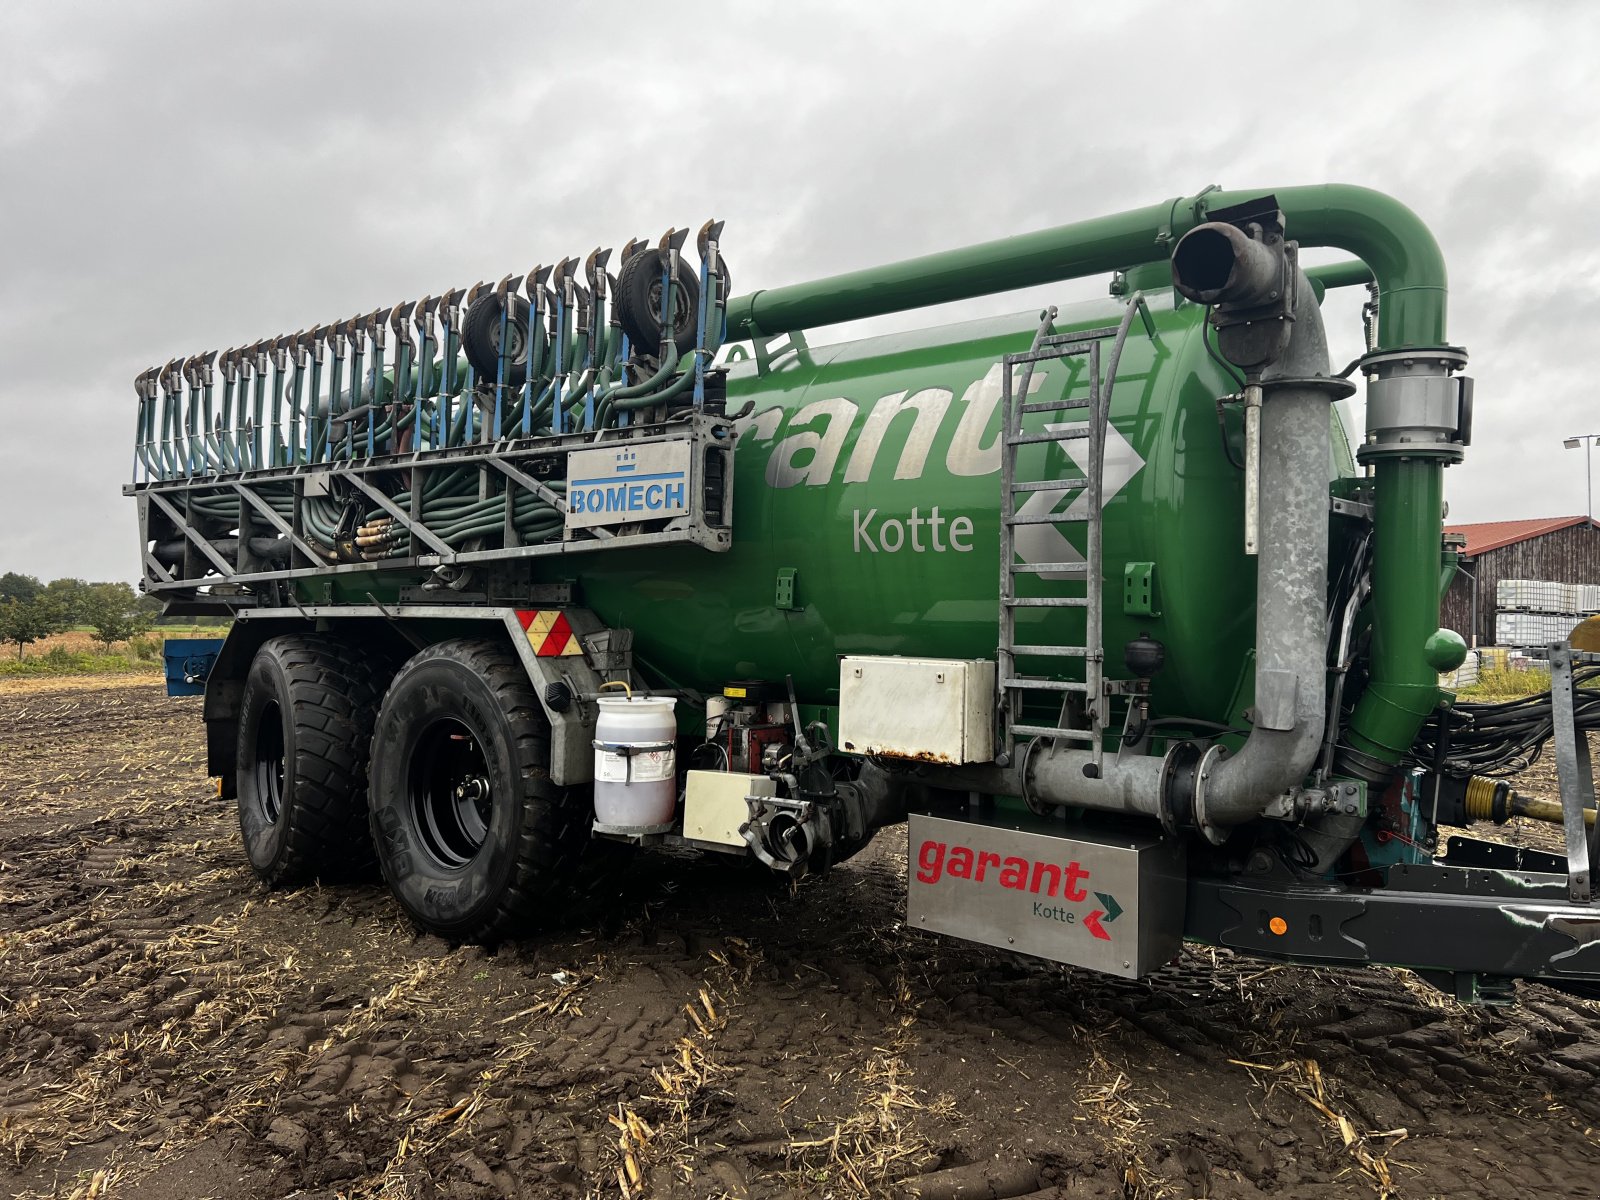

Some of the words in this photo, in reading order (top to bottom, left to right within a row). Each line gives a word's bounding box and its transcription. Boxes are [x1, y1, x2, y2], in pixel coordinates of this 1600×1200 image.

[570, 482, 685, 514] BOMECH
[853, 505, 975, 553] Kotte
[916, 840, 1091, 903] garant
[1033, 901, 1076, 925] Kotte
